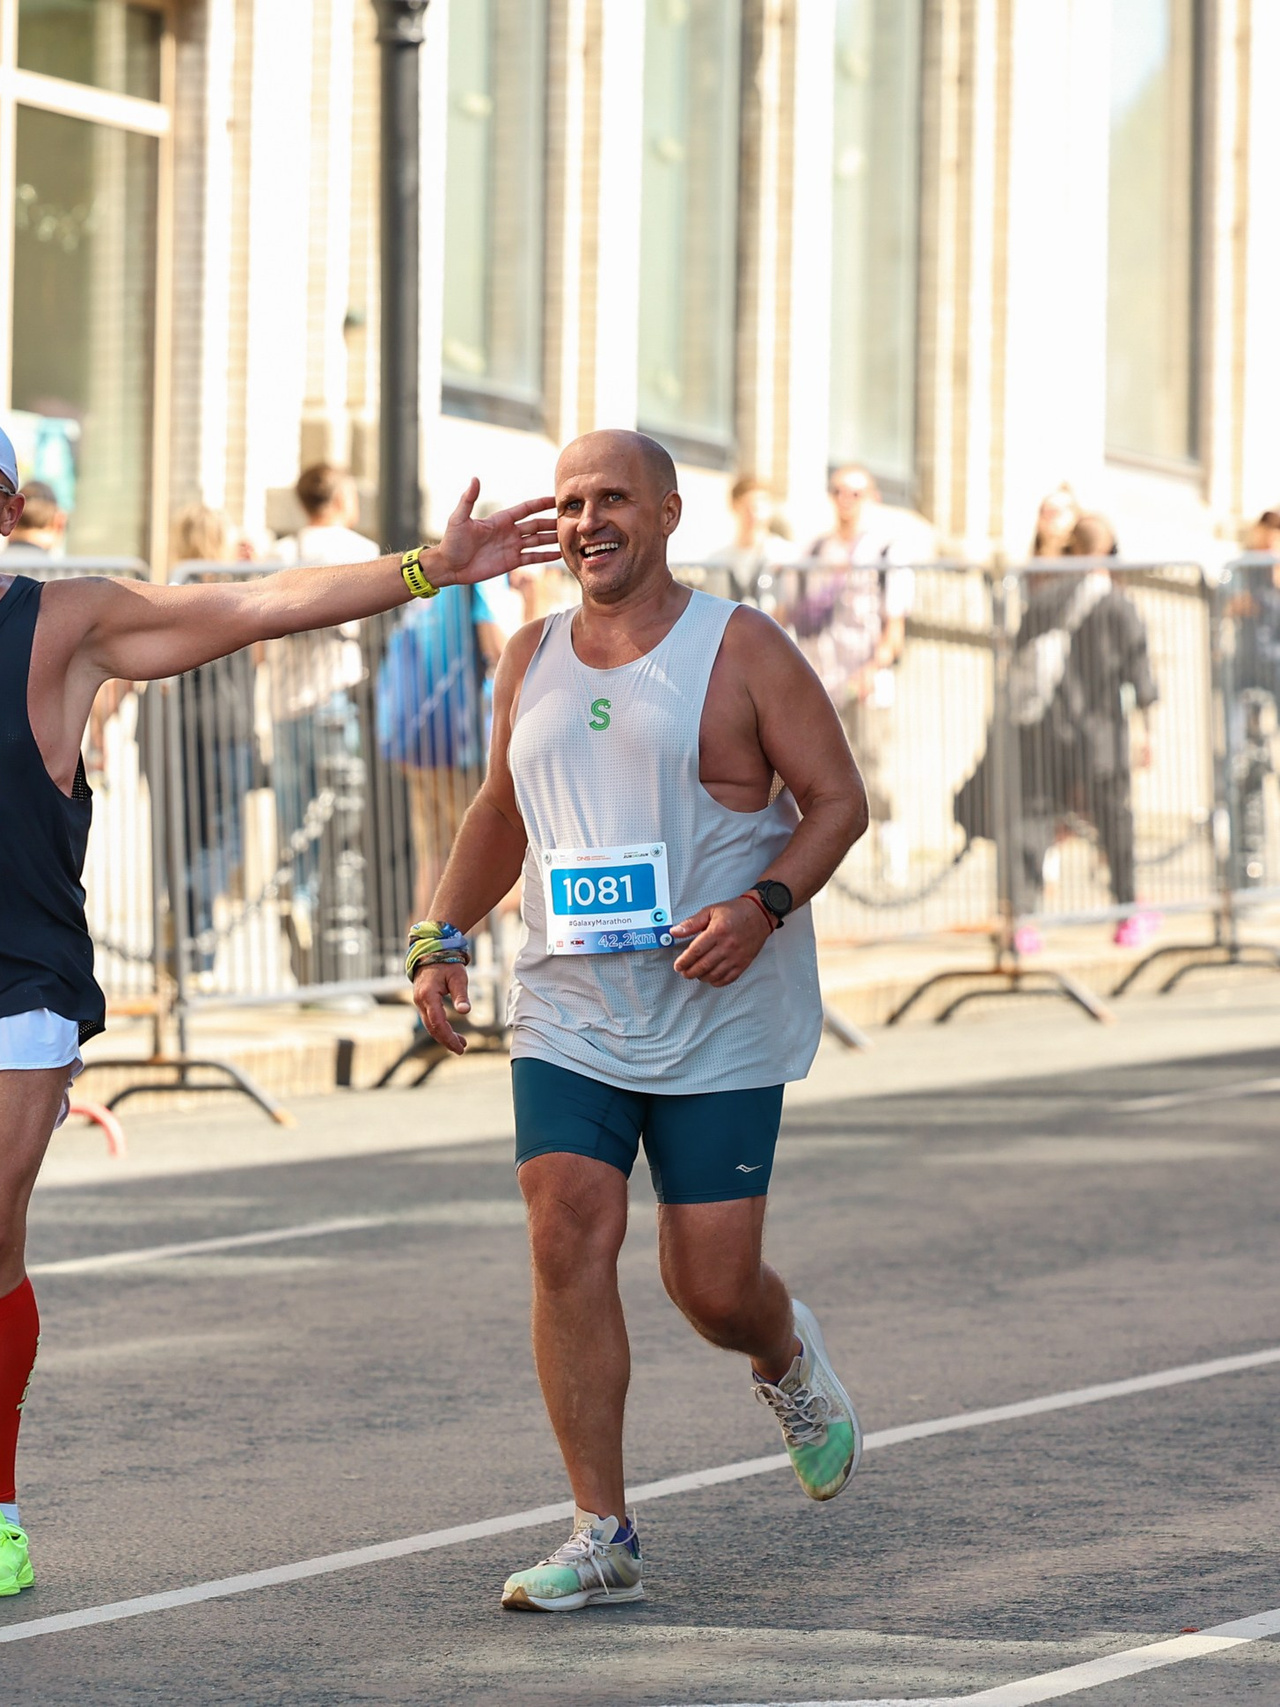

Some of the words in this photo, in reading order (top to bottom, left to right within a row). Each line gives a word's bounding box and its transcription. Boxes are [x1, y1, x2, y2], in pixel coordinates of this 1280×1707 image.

[589, 698, 611, 731] S
[562, 875, 633, 907] 1081
[568, 917, 632, 928] #GalaxyMarathon
[653, 911, 664, 922] C
[597, 931, 657, 949] 42,2km
